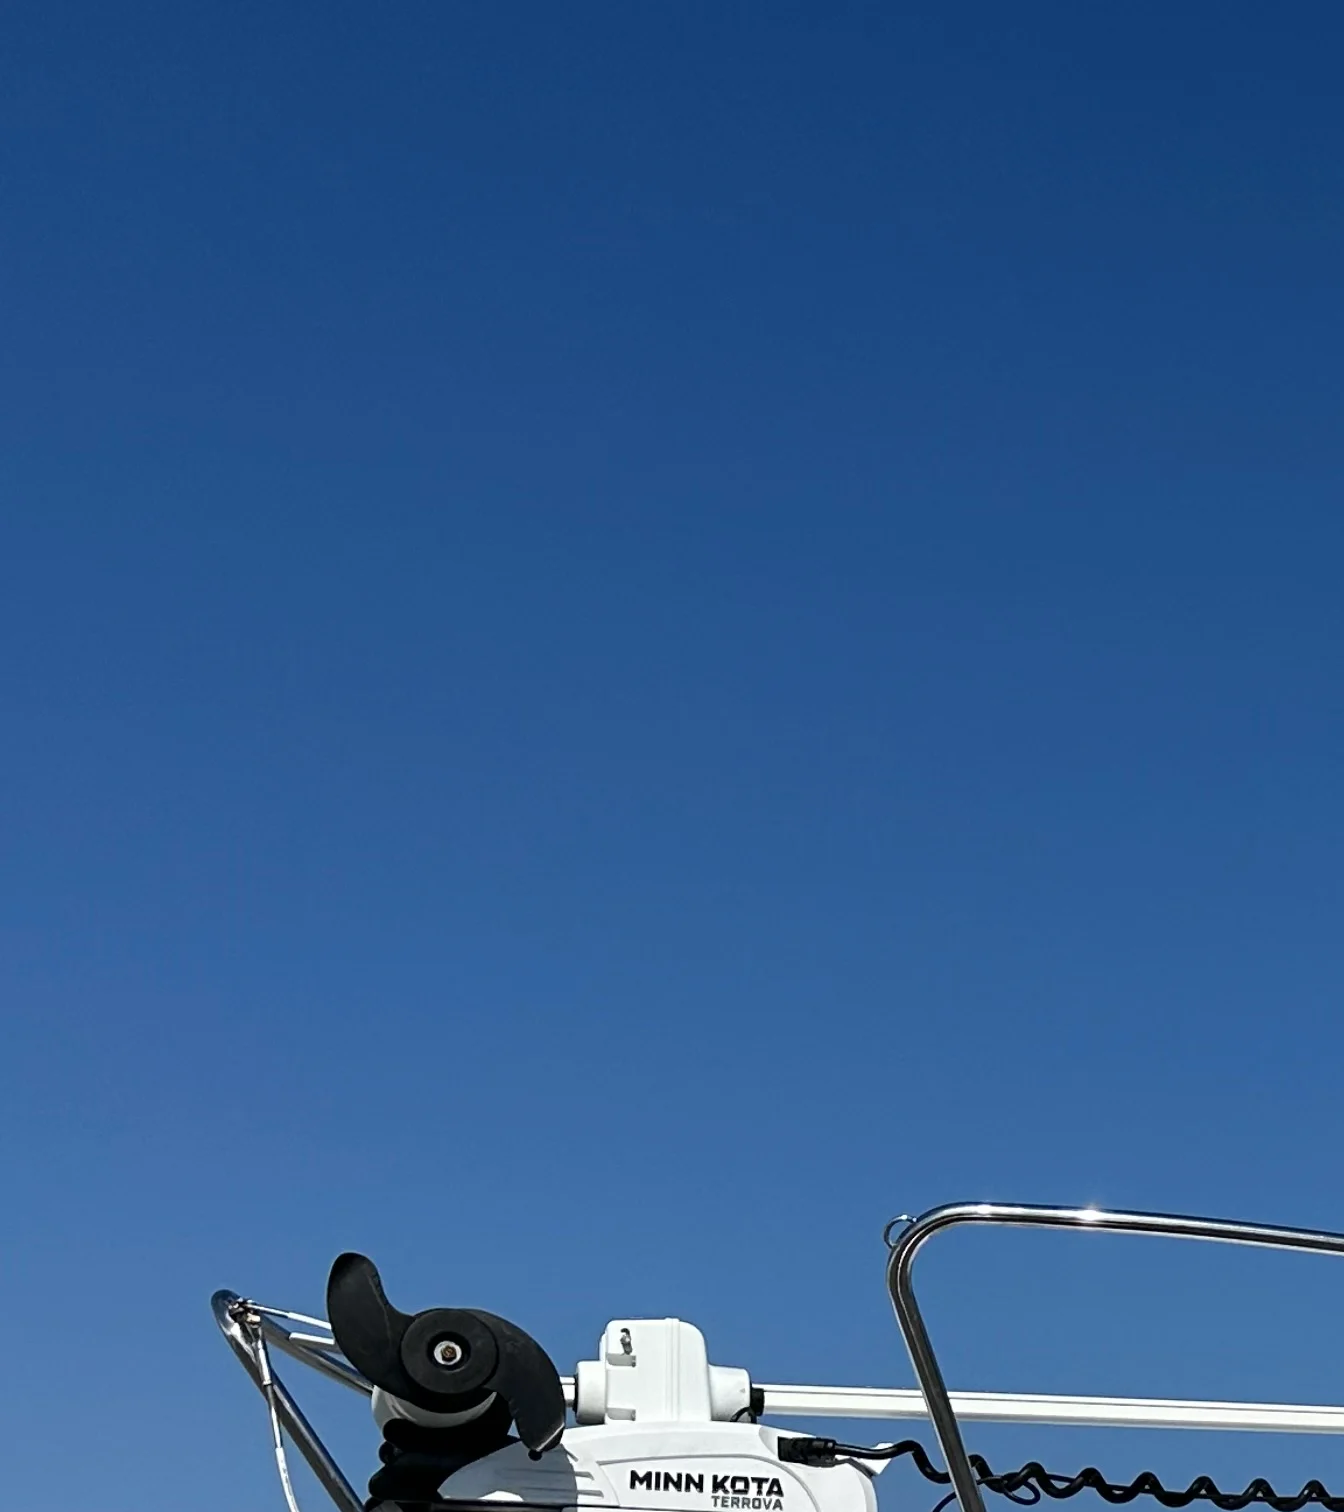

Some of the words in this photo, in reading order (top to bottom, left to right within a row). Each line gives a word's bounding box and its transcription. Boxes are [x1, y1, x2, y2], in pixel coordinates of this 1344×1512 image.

[629, 1469, 704, 1494] MINN
[711, 1474, 784, 1498] KOTA
[711, 1495, 783, 1511] TERROVA
